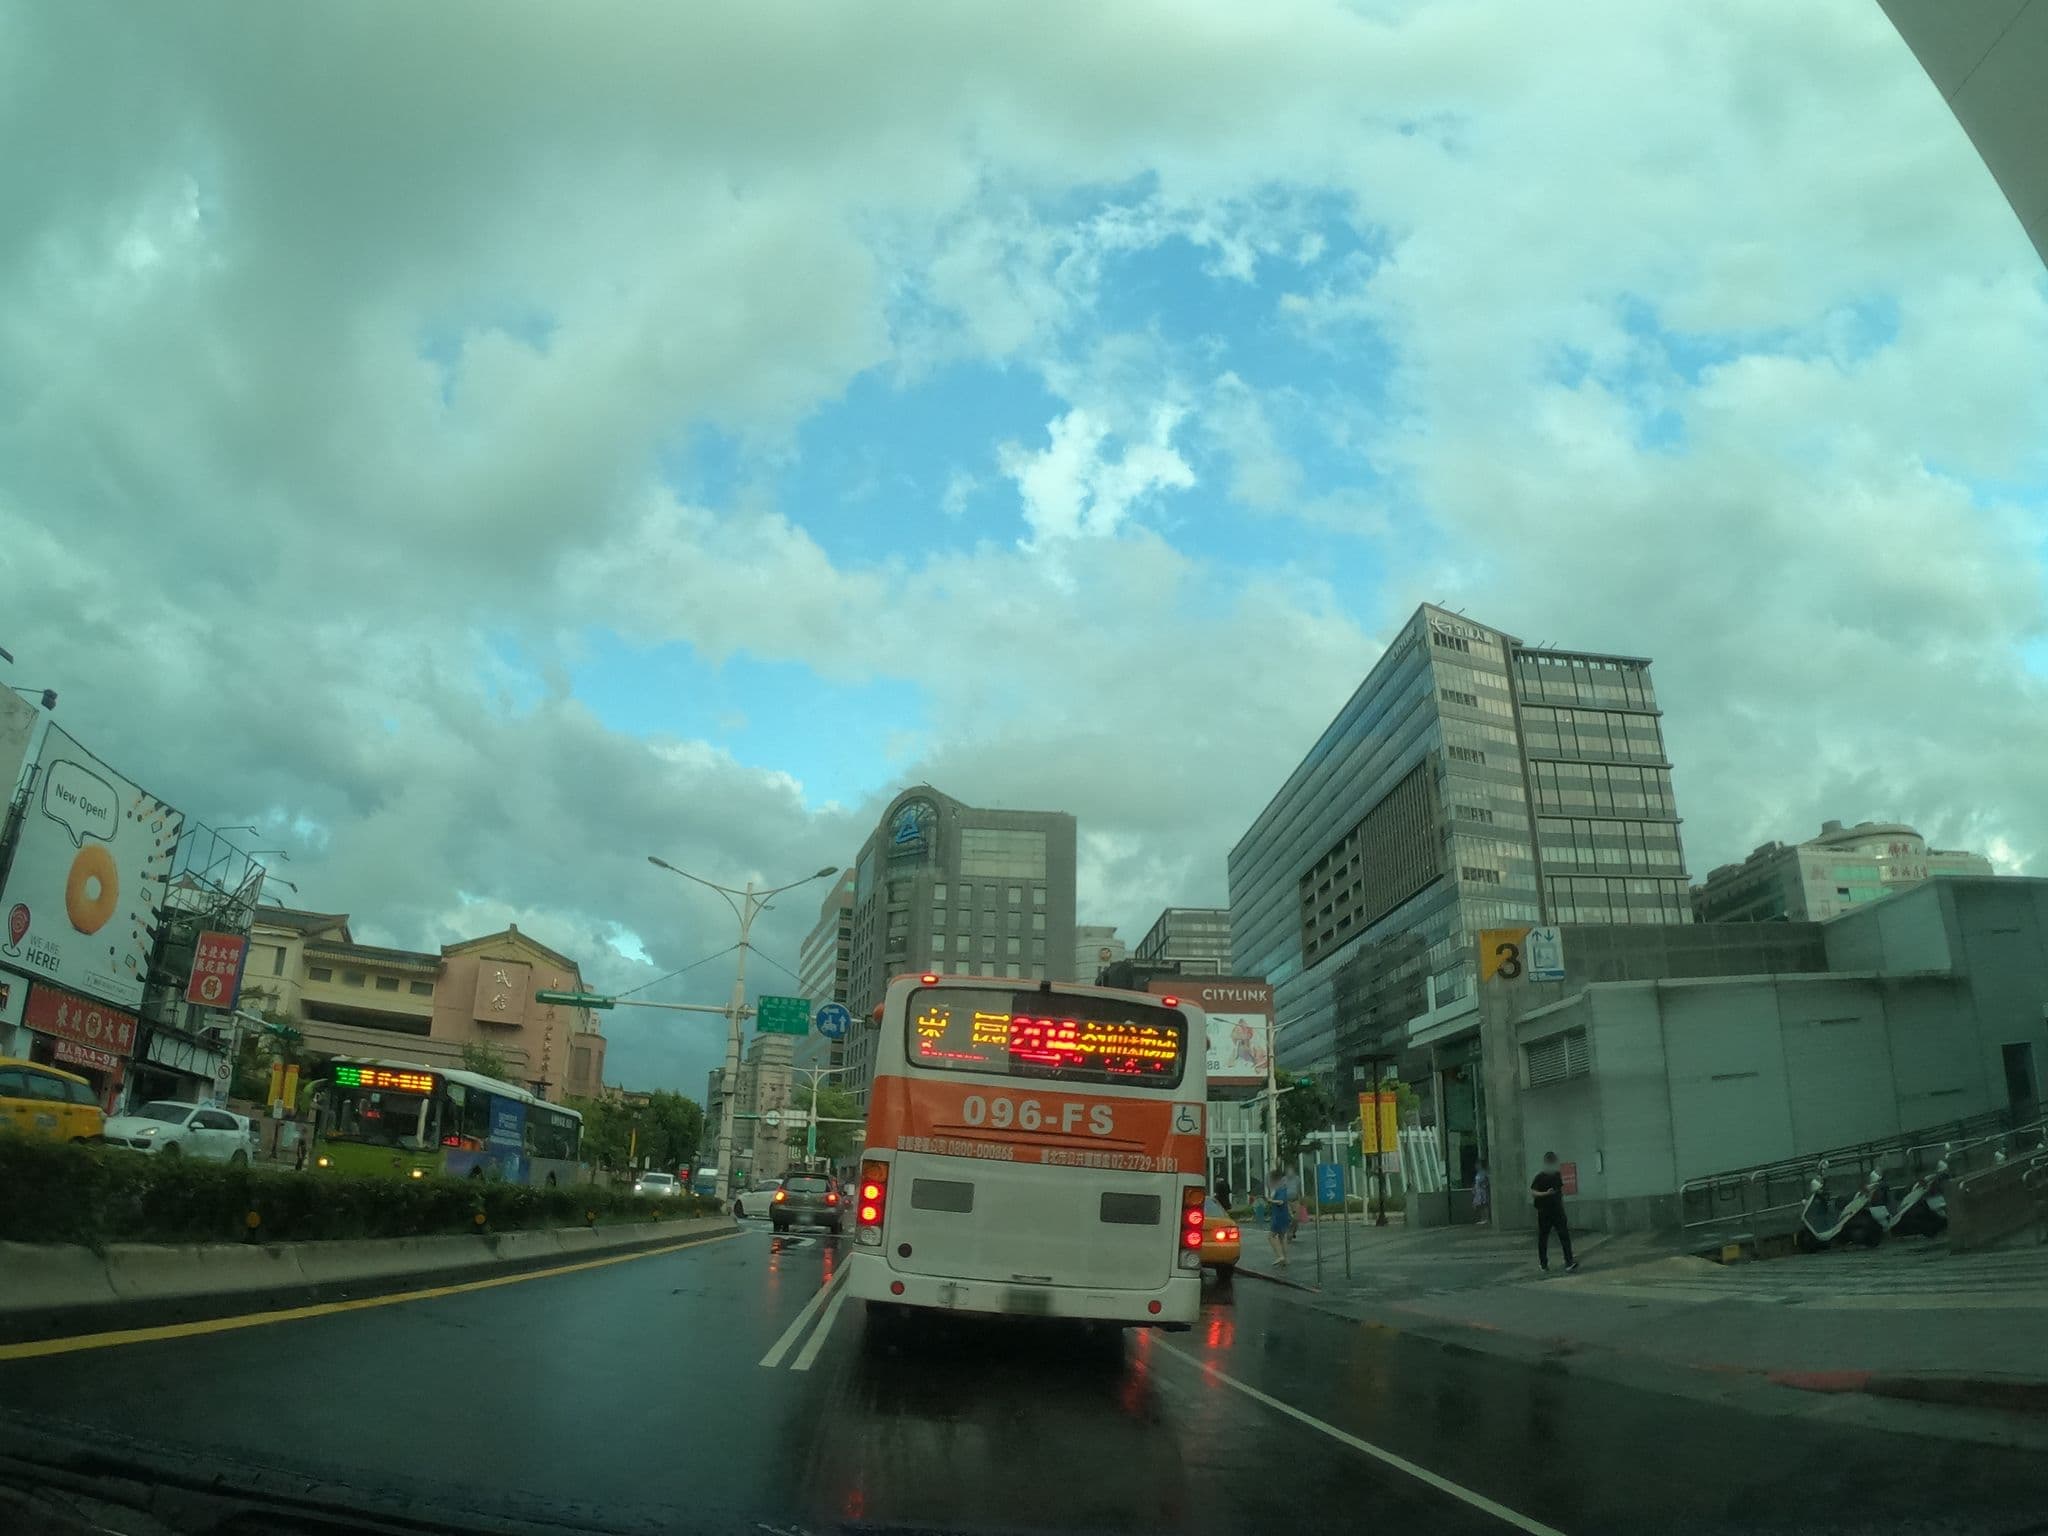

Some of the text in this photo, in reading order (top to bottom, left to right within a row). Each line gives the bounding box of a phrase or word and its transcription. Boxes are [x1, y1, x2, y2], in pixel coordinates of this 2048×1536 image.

[56, 783, 107, 820] New Open!
[26, 947, 60, 972] HERE!
[1496, 943, 1521, 979] 3
[1202, 988, 1268, 1001] CITYLINK
[963, 1095, 1114, 1135] 096-FS
